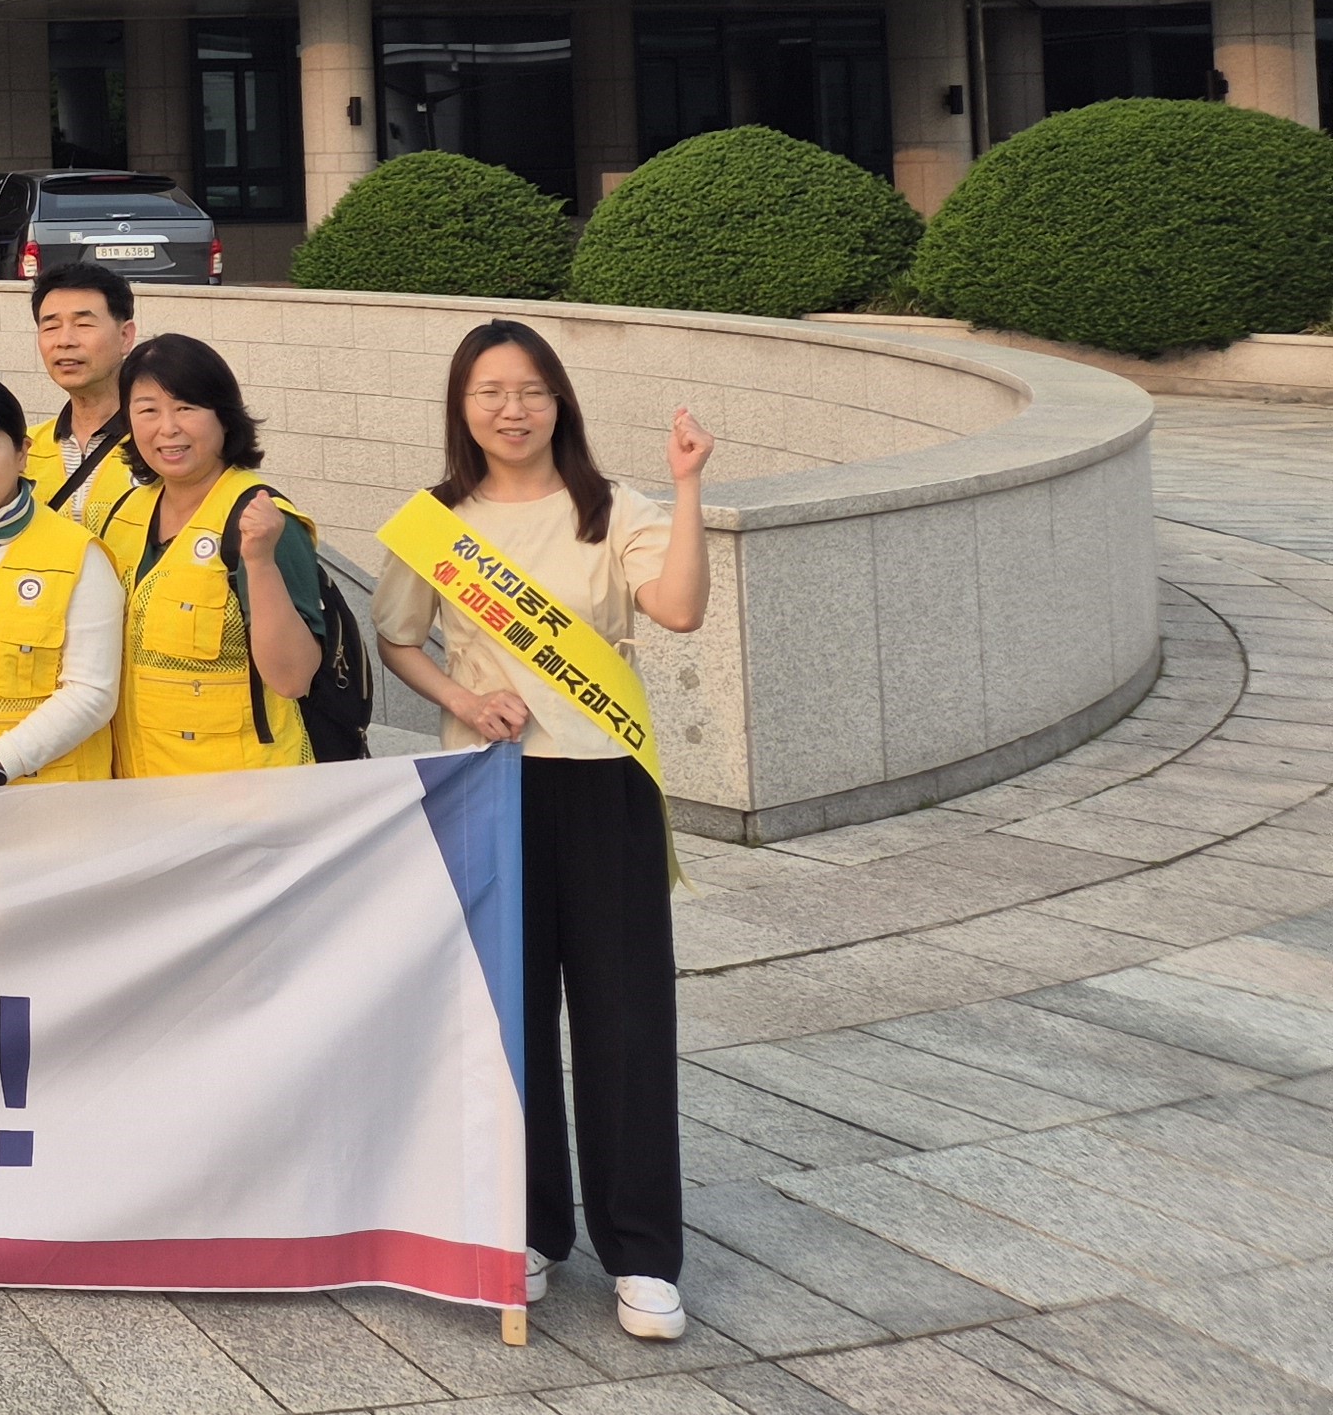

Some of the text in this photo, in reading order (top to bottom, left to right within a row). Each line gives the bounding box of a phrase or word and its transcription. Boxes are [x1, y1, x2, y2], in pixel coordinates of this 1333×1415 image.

[124, 247, 150, 256] 6388
[452, 533, 573, 638] 청소년에게
[531, 644, 647, 752] 팔지맙시다
